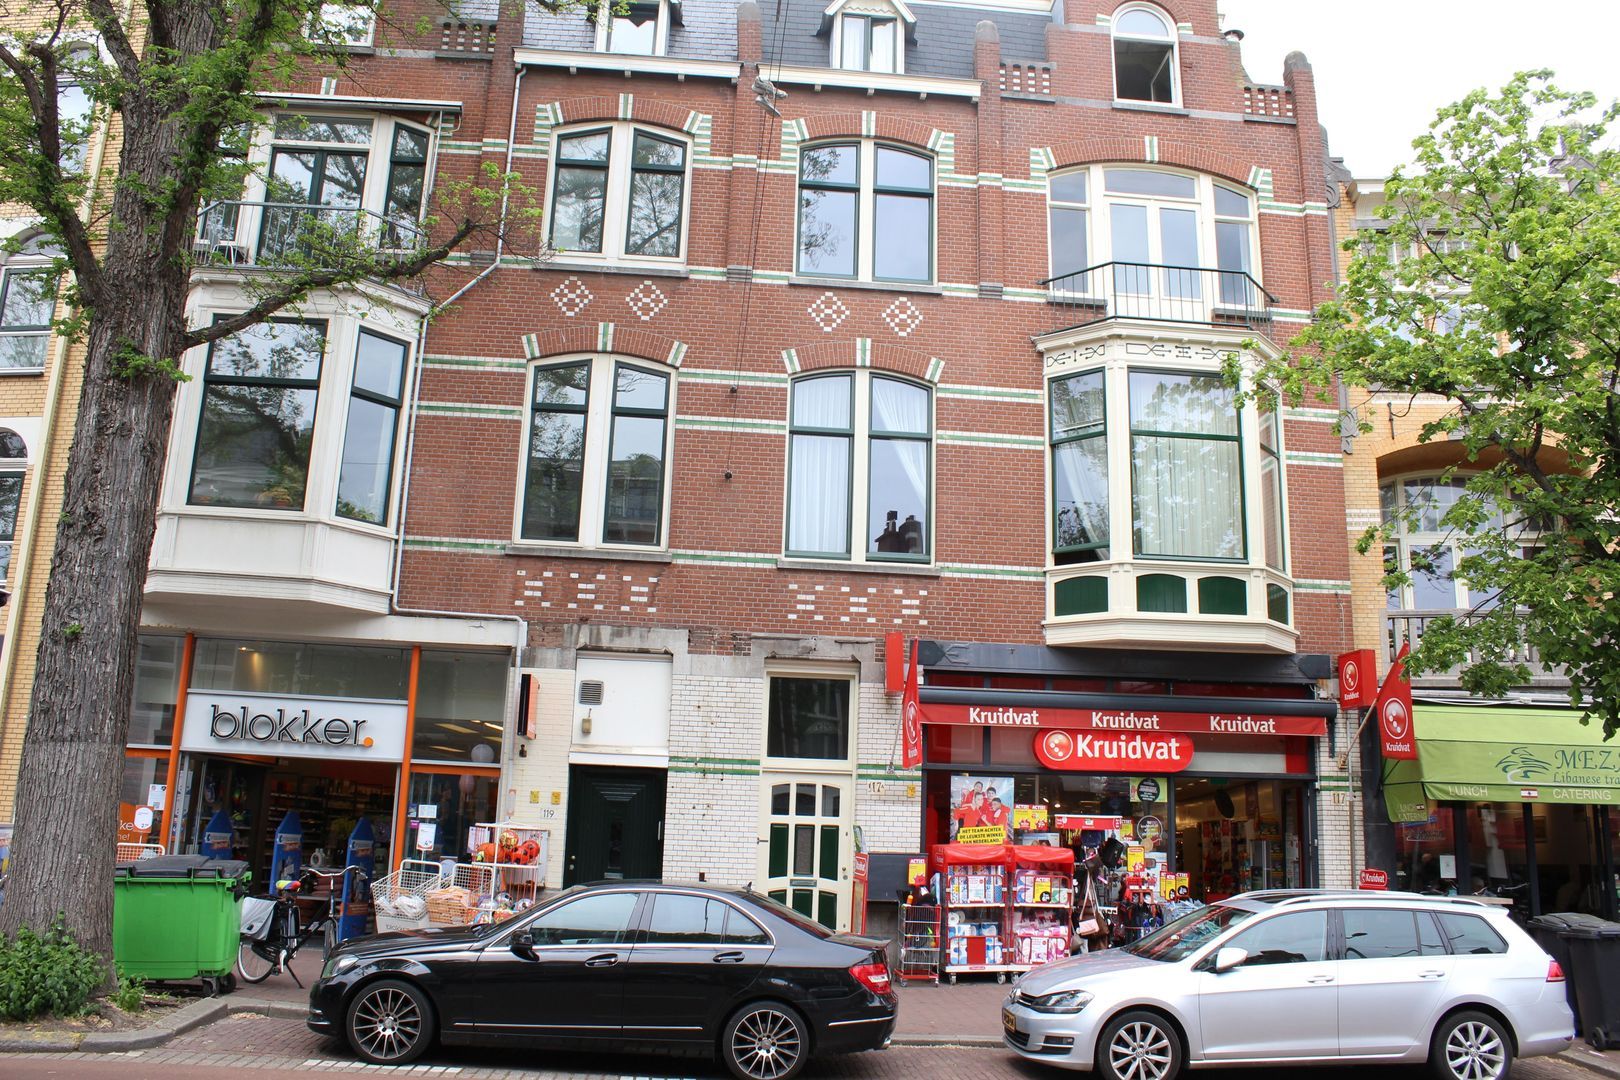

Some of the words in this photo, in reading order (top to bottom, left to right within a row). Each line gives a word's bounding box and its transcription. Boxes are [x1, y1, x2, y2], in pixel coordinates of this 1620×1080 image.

[969, 707, 1039, 726] Kruidvat
[1092, 711, 1160, 730] Kruidvat
[1210, 715, 1276, 733] Kruidvat
[1076, 734, 1181, 761] Kruidvat
[1386, 742, 1411, 752] Kruidvat
[1554, 749, 1620, 772] MEZ
[1553, 771, 1601, 784] Libanese
[1448, 785, 1489, 797] LUNCH
[1552, 788, 1612, 800] CATERING
[1332, 793, 1346, 804] 117
[543, 809, 555, 818] 119
